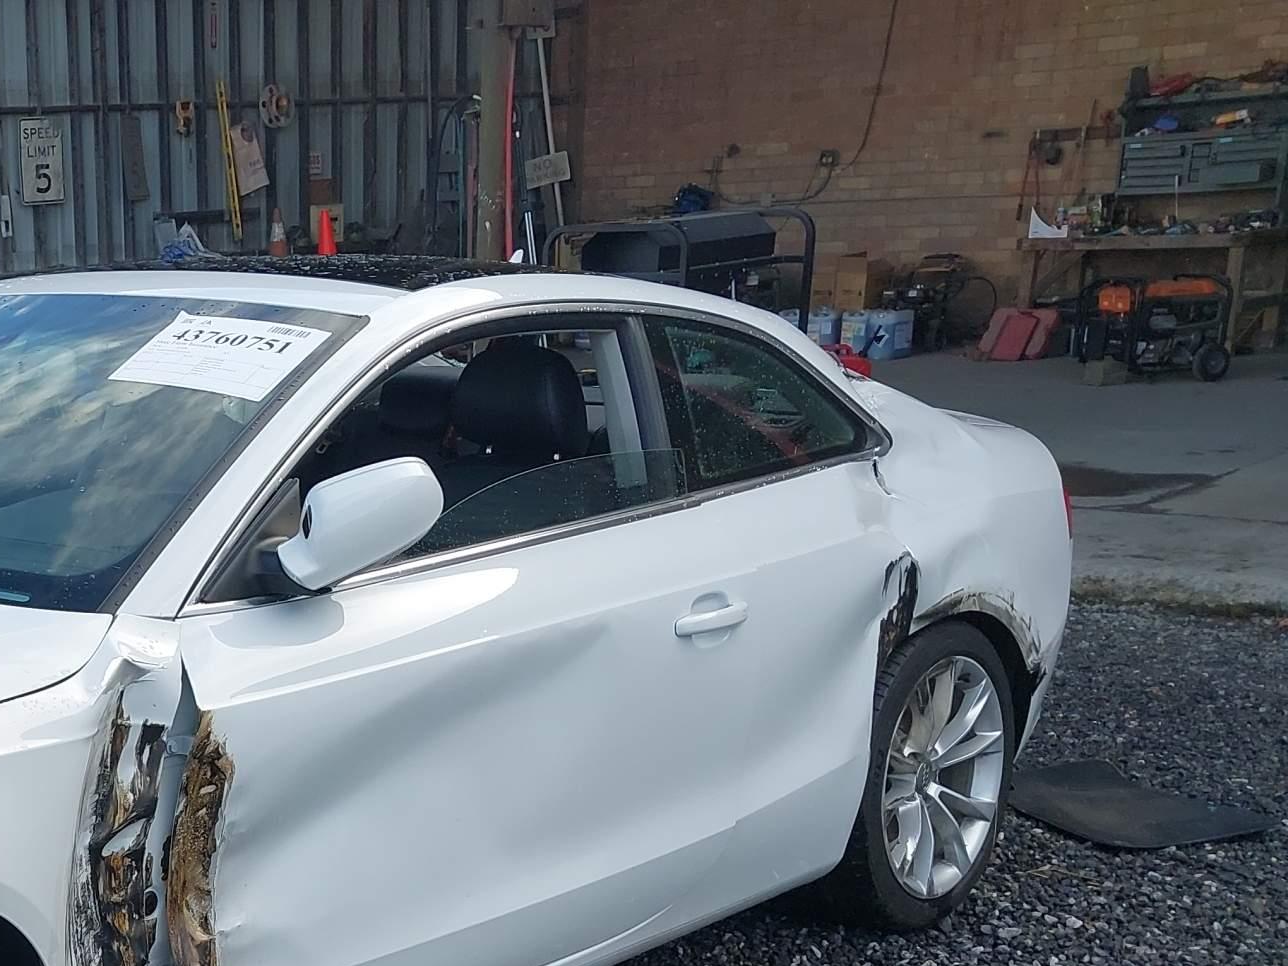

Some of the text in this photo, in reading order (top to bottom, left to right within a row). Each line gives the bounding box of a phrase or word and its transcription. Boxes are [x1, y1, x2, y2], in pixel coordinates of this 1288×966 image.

[23, 127, 60, 140] SPEED
[27, 145, 57, 158] LIMIT
[35, 163, 52, 194] 5
[172, 328, 293, 355] 43760751
